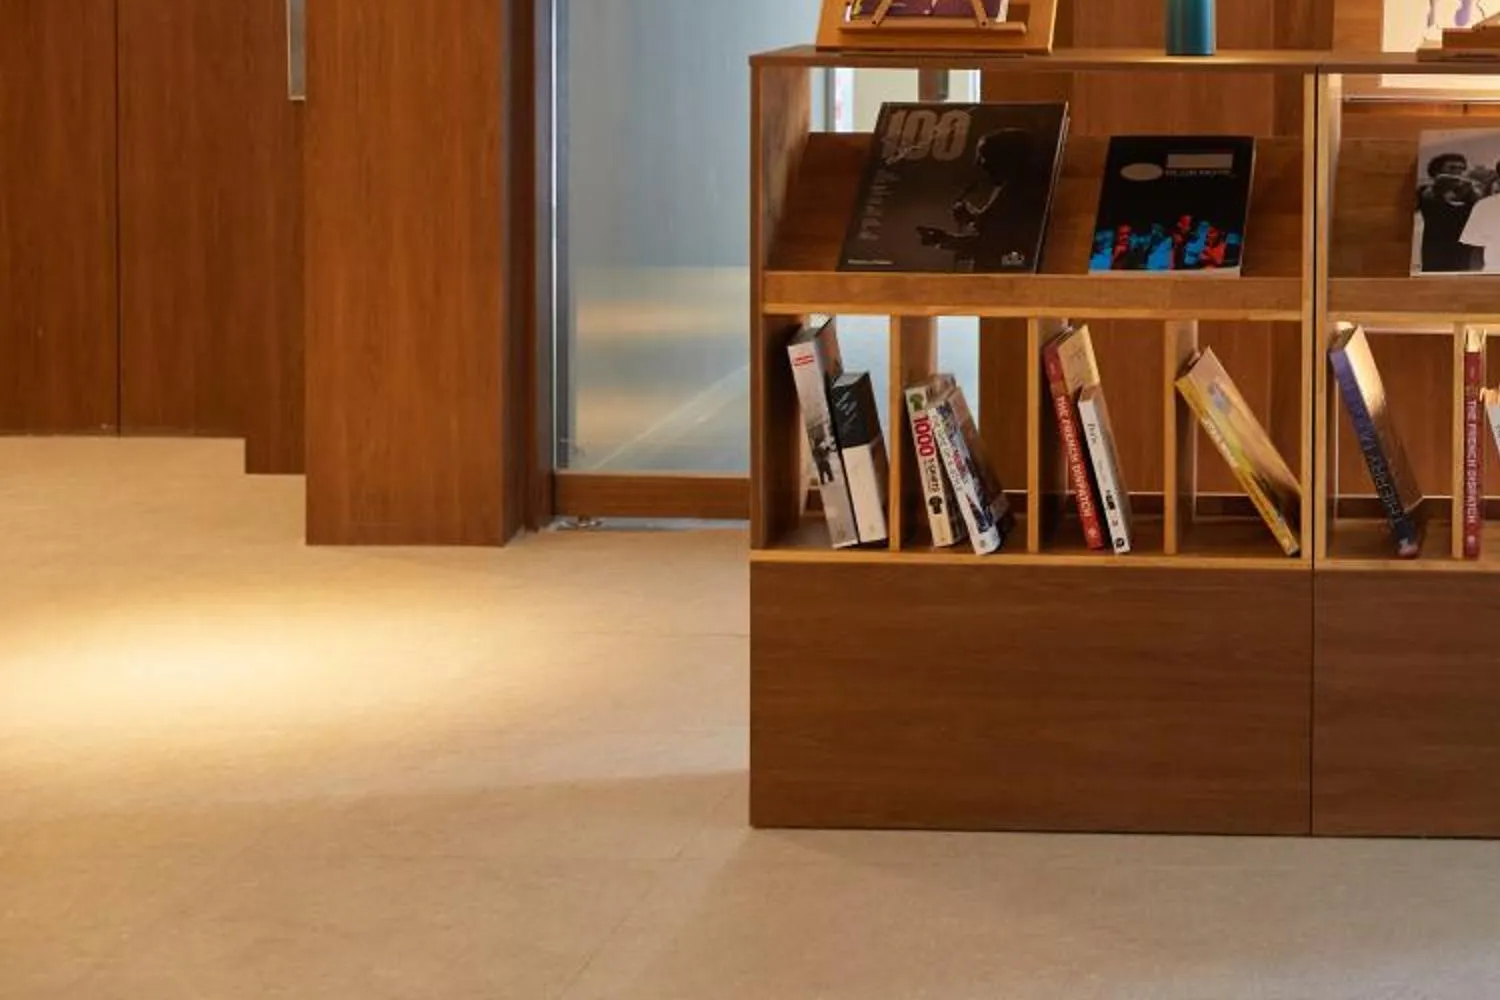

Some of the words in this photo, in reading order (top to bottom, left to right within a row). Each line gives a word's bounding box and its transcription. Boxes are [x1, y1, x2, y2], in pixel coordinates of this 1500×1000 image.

[881, 108, 972, 161] 100
[1055, 395, 1069, 417] THE
[1467, 400, 1476, 419] THE
[913, 416, 936, 457] 1000
